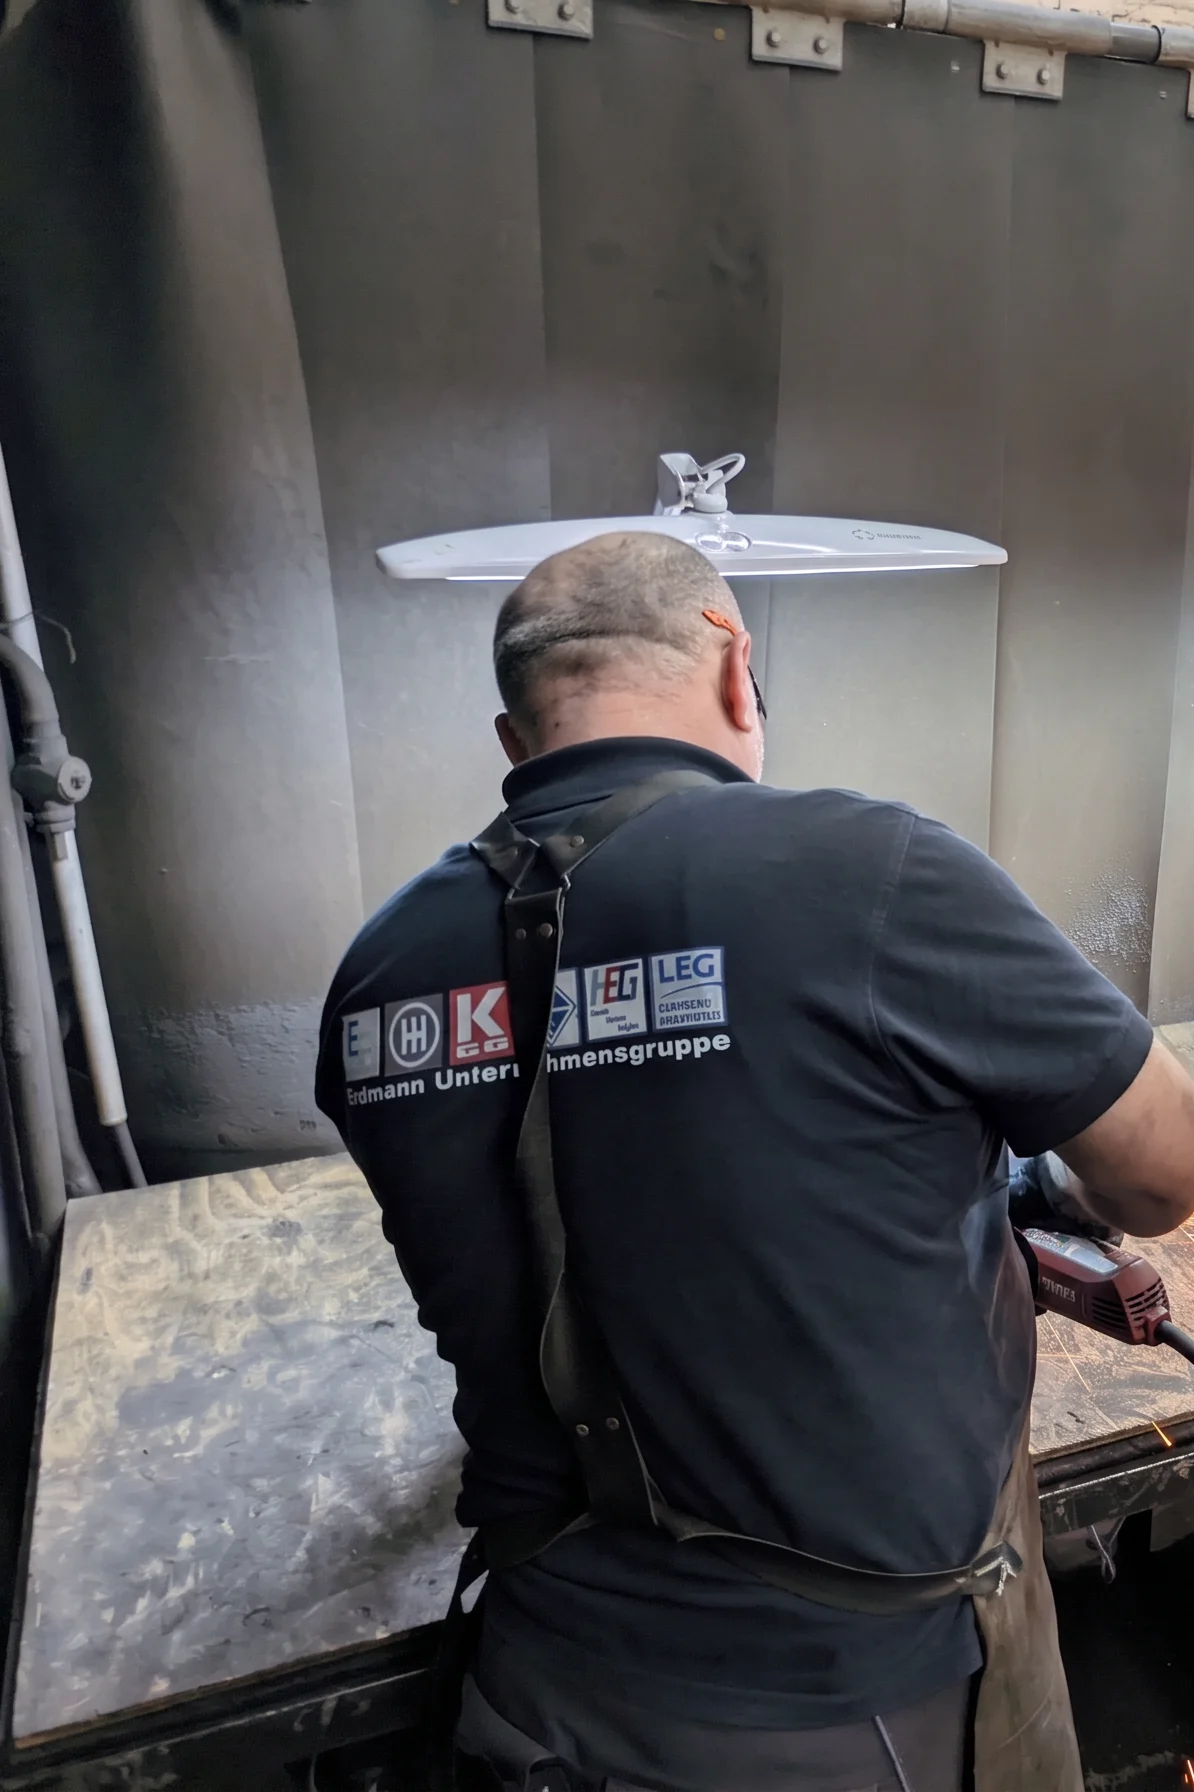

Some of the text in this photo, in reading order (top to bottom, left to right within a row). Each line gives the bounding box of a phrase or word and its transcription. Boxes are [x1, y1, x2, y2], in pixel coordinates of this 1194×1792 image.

[658, 953, 715, 984] LEG
[590, 962, 640, 1007] HEG
[346, 1078, 425, 1106] Erdmann
